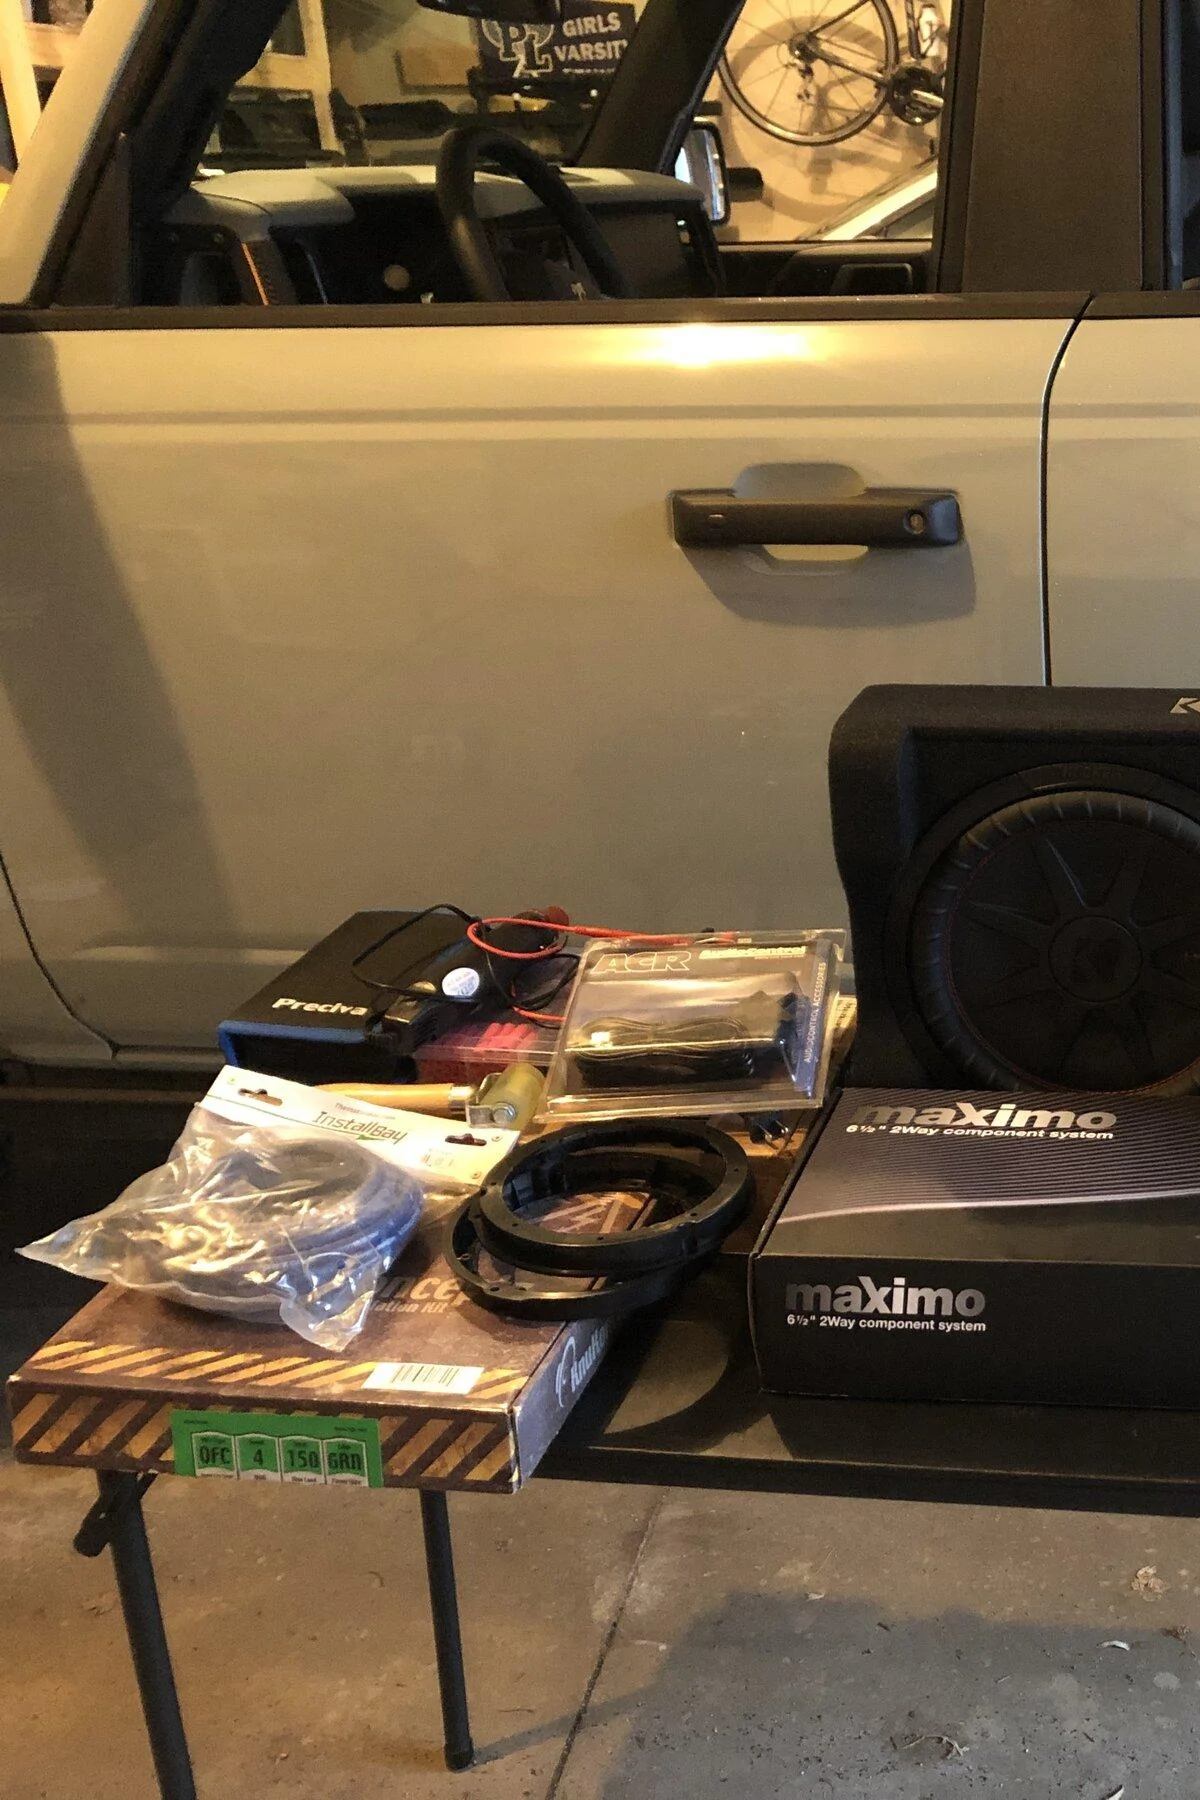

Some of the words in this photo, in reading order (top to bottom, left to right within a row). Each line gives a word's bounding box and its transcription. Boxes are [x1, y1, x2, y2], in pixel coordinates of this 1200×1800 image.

[562, 12, 621, 37] GIRLS
[589, 950, 692, 974] ACR
[272, 997, 369, 1016] Preciva
[312, 1110, 408, 1146] InstallBay
[889, 1125, 939, 1136] 2Way
[943, 1127, 1046, 1138] component
[1049, 1129, 1114, 1140] system
[819, 1316, 856, 1330] 2Way
[858, 1317, 935, 1331] component
[938, 1321, 986, 1333] system
[253, 1448, 264, 1466] 4
[289, 1449, 320, 1468] 150
